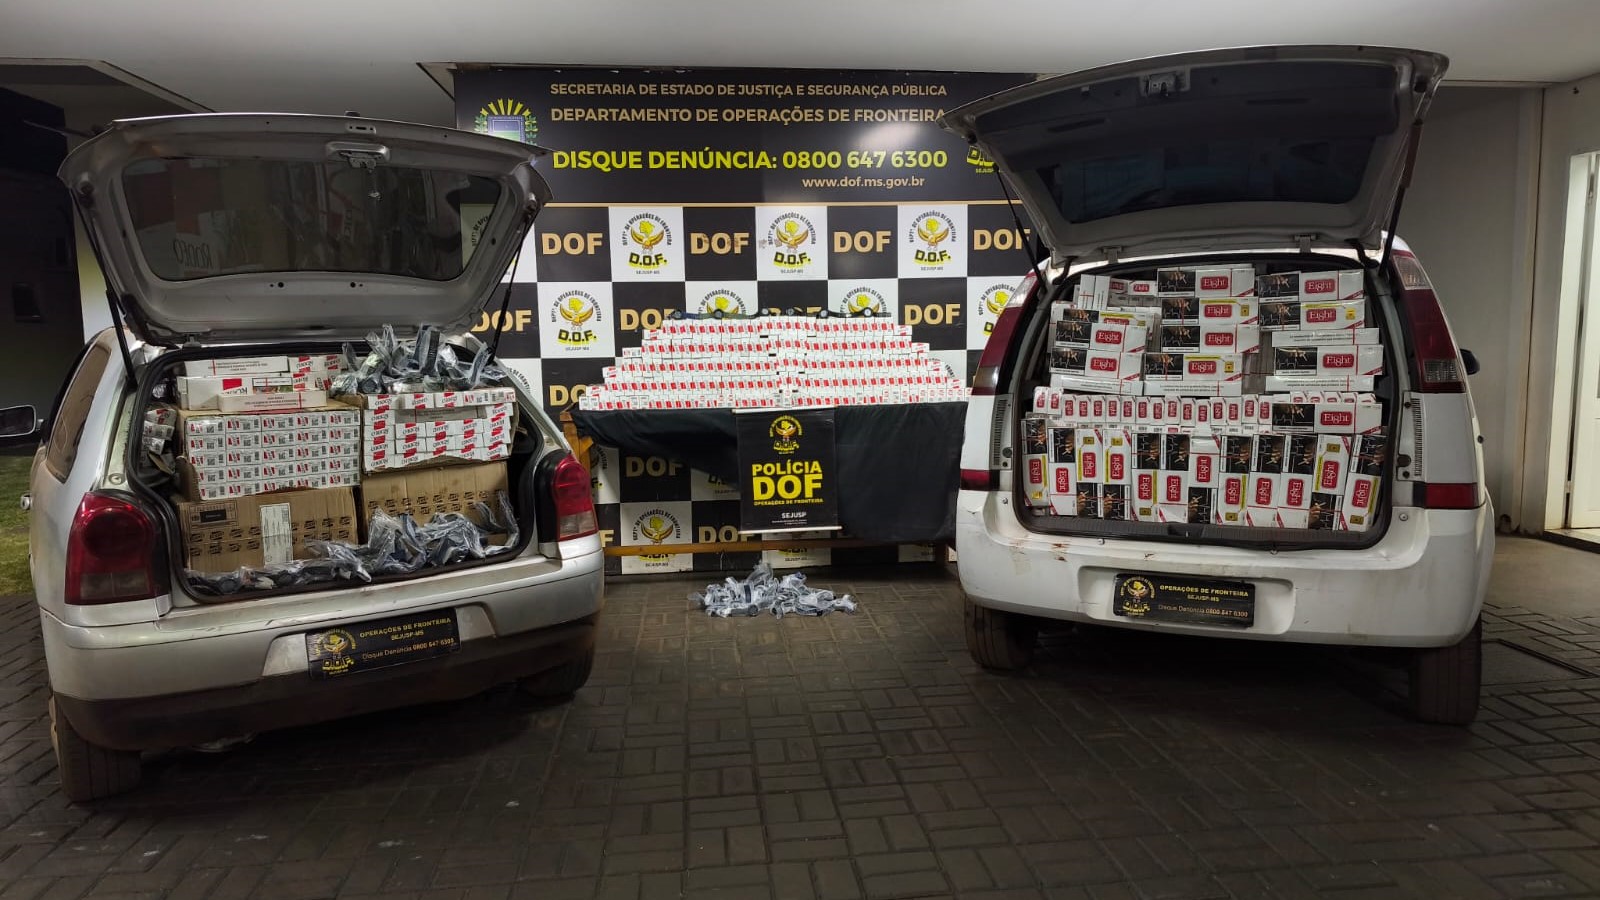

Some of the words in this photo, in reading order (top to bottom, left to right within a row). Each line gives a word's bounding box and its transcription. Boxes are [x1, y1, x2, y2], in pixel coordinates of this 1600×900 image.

[550, 83, 635, 96] SECRETARIA
[639, 84, 657, 95] DE
[660, 84, 714, 96] ESTADO
[718, 84, 735, 96] DE
[738, 84, 793, 97] JUSTIÇA
[796, 85, 804, 96] E
[808, 84, 889, 98] SEGURANÇA
[892, 82, 947, 96] PÚBLICA
[551, 108, 692, 121] DEPARTAMENTO
[696, 108, 718, 122] DE
[722, 106, 824, 126] OPERAÇÕES
[828, 108, 850, 122] DE
[854, 108, 945, 122] FRONTEIRA
[552, 150, 642, 172] DISQUE
[648, 147, 778, 168] DENÚNCIA:
[782, 150, 841, 168] 0800
[846, 150, 886, 168] 647
[890, 150, 948, 168] 6300
[802, 176, 925, 189] www.dof.ms.gov.br
[542, 233, 602, 254] DOF
[690, 232, 750, 254] DOF
[834, 231, 892, 252] DOF
[973, 228, 1030, 250] DOF
[629, 252, 668, 266] D.O.F.
[774, 252, 811, 264] D.O.F.
[915, 250, 951, 262] D.O.F.
[1204, 278, 1226, 288] Eight
[1308, 280, 1332, 292] Eight
[904, 304, 960, 326] DOF
[1207, 306, 1230, 316] Eight
[1309, 310, 1334, 321] Eight
[558, 329, 597, 342] D.O.F.
[1098, 332, 1120, 343] Eight
[1208, 334, 1231, 345] Eight
[1092, 360, 1115, 371] Eight
[1190, 362, 1214, 374] Eight
[1326, 356, 1352, 367] Eight
[549, 384, 587, 406] DO
[1324, 414, 1350, 424] Eight
[625, 456, 683, 477] DOF
[752, 459, 822, 476] POLÍCIA
[1031, 460, 1040, 482] Eight
[1084, 454, 1094, 476] Eight
[1112, 456, 1122, 477] Eight
[1199, 459, 1208, 480] Eight
[1323, 464, 1335, 486] Eight
[752, 473, 823, 500] DOF
[1058, 470, 1068, 490] Eight
[1141, 476, 1151, 497] Eight
[1170, 478, 1179, 498] Eight
[1228, 481, 1238, 502] Eight
[1258, 480, 1270, 502] Eight
[1290, 482, 1300, 504] Eight
[1357, 483, 1368, 504] Eight
[1160, 584, 1199, 593] OPERAÇÕES
[1210, 588, 1249, 597] FRONTEIRA
[360, 624, 402, 638] OPERAÇÕES
[413, 618, 452, 629] FRONTEIRA
[362, 650, 384, 660] Disque
